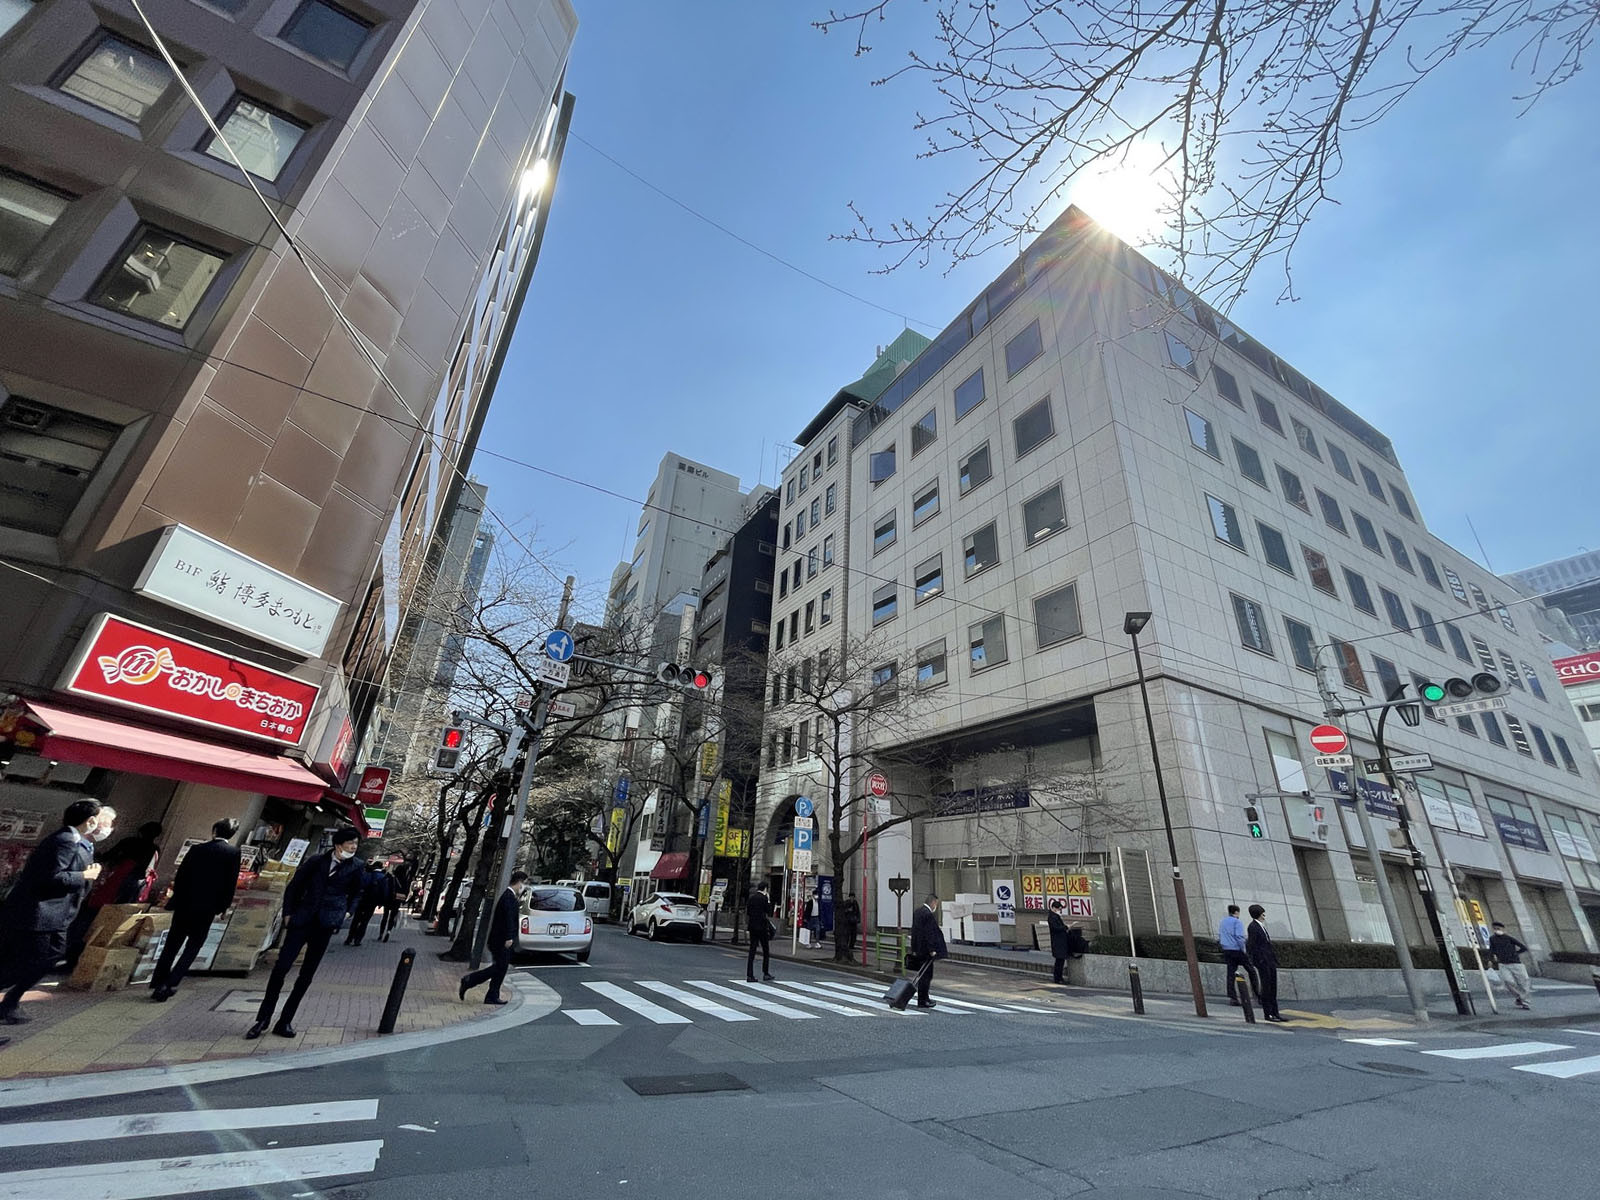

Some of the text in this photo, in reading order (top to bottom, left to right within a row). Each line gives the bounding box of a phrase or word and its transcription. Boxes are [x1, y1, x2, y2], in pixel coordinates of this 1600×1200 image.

[174, 559, 202, 578] B1F
[205, 569, 227, 594] 鮨
[234, 582, 314, 630] 博多まつもと
[167, 665, 303, 721] おかしのまちおか
[1436, 699, 1504, 717] 自転車専用
[260, 719, 294, 734] 日本橋店
[1316, 757, 1352, 767] 自転車を除く
[1367, 763, 1380, 772] 14
[800, 801, 807, 813] P
[798, 832, 809, 847] P
